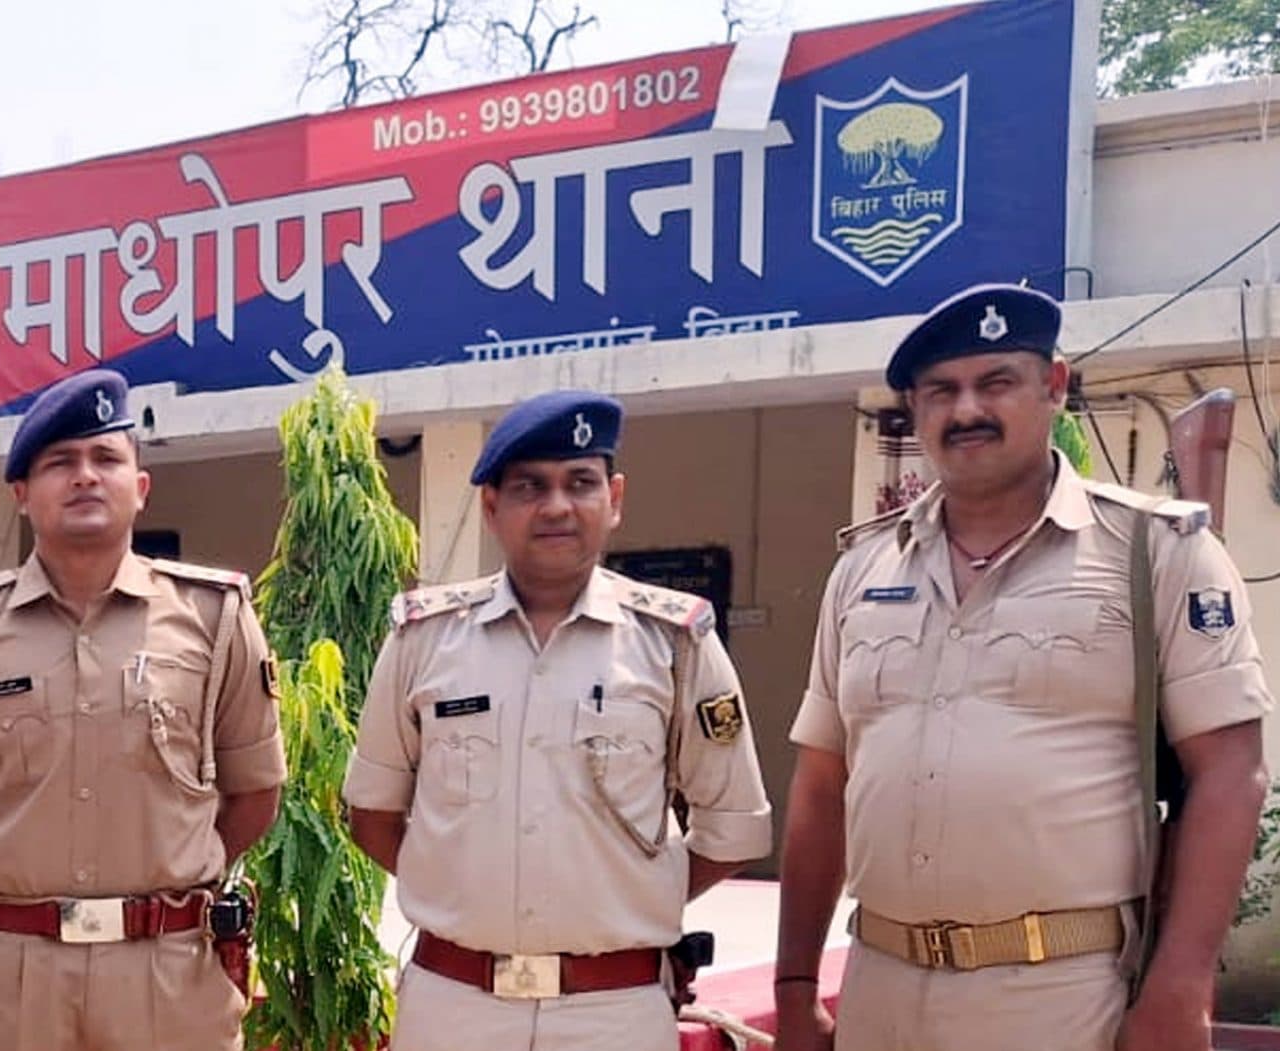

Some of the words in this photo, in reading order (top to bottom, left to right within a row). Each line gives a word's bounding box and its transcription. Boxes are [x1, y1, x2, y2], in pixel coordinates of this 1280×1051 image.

[373, 109, 468, 150] Mob.:
[479, 66, 700, 133] 9939801802
[457, 119, 795, 302] थाना
[831, 195, 882, 218] बिहार
[890, 186, 948, 217] पुलिस
